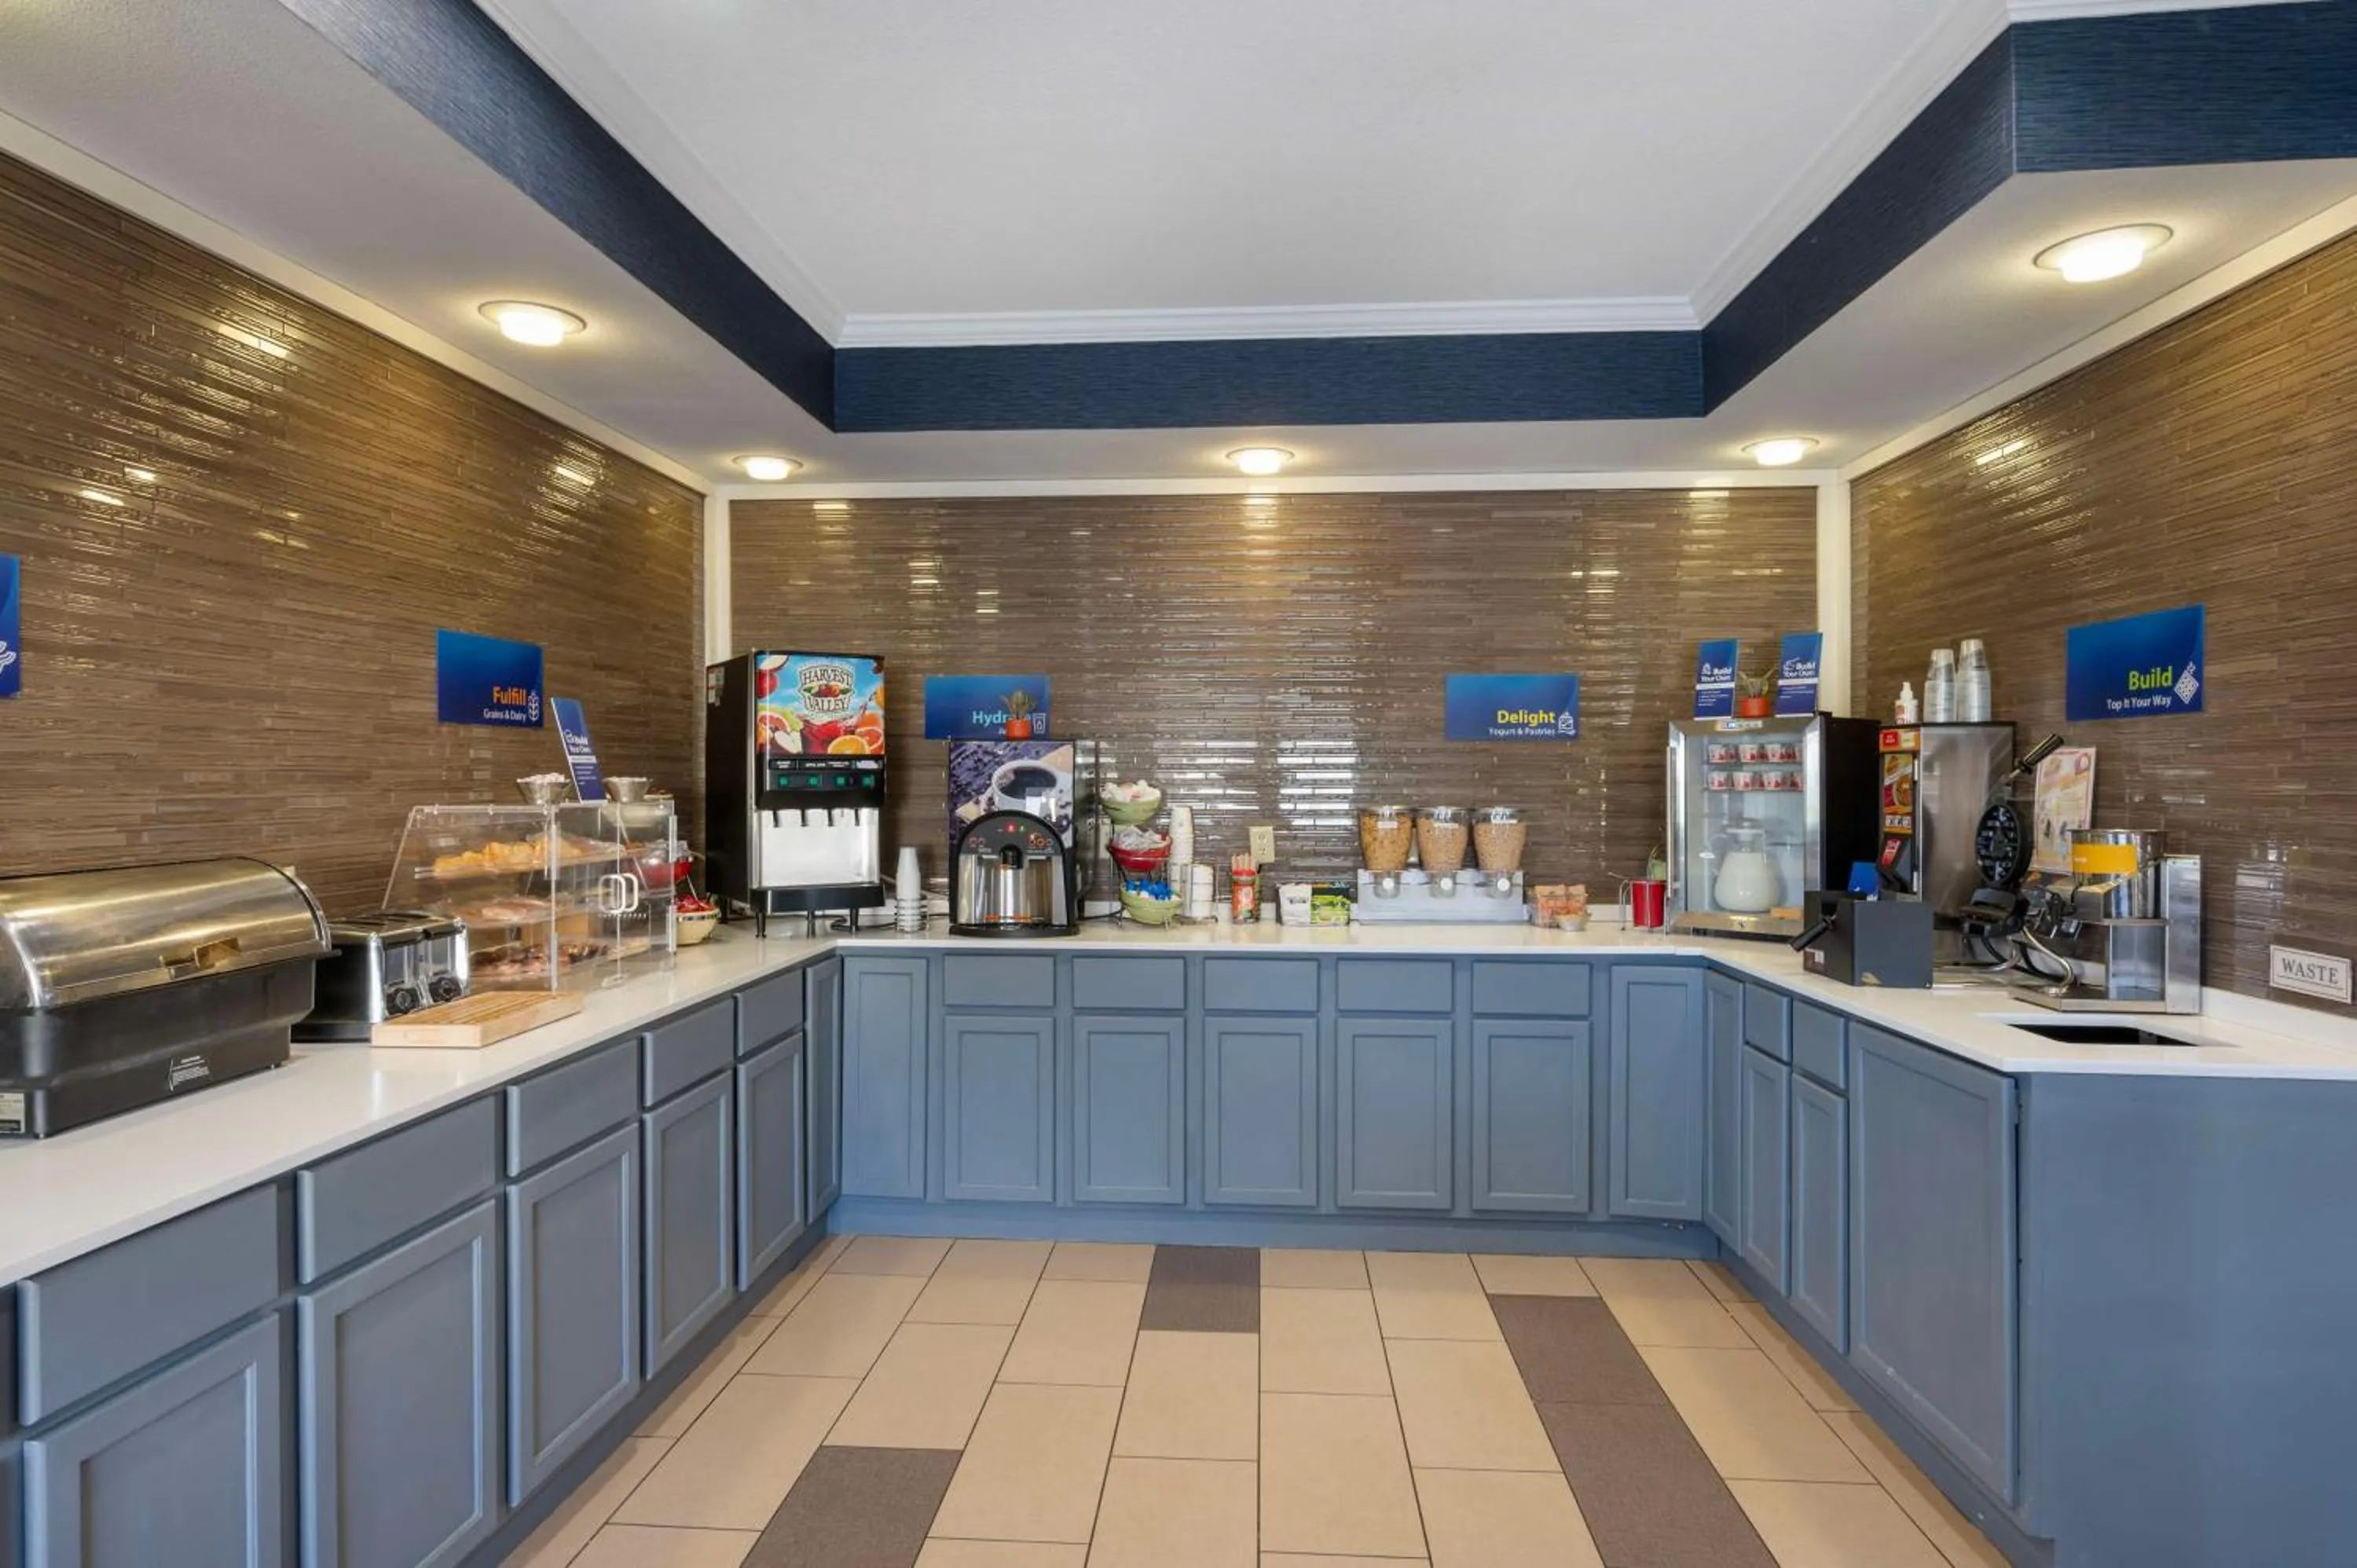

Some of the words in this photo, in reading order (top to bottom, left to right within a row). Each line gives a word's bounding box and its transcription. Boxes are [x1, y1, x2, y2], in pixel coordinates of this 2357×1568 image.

[804, 669, 851, 686] HARVEST
[2128, 665, 2173, 691] Build
[493, 686, 527, 706] Fulfill
[806, 695, 847, 712] VALLEY
[2106, 698, 2123, 712] Top
[2124, 698, 2130, 709] It
[2132, 697, 2151, 708] Your
[2152, 694, 2172, 708] Way
[483, 708, 504, 720] Grains
[504, 709, 510, 720] &
[510, 709, 527, 723] Dairy
[1497, 709, 1556, 727] Delight
[1489, 727, 1516, 737] Yogurt
[1517, 727, 1524, 735] &
[1525, 727, 1556, 735] Pastries
[2282, 958, 2339, 984] WASTE
